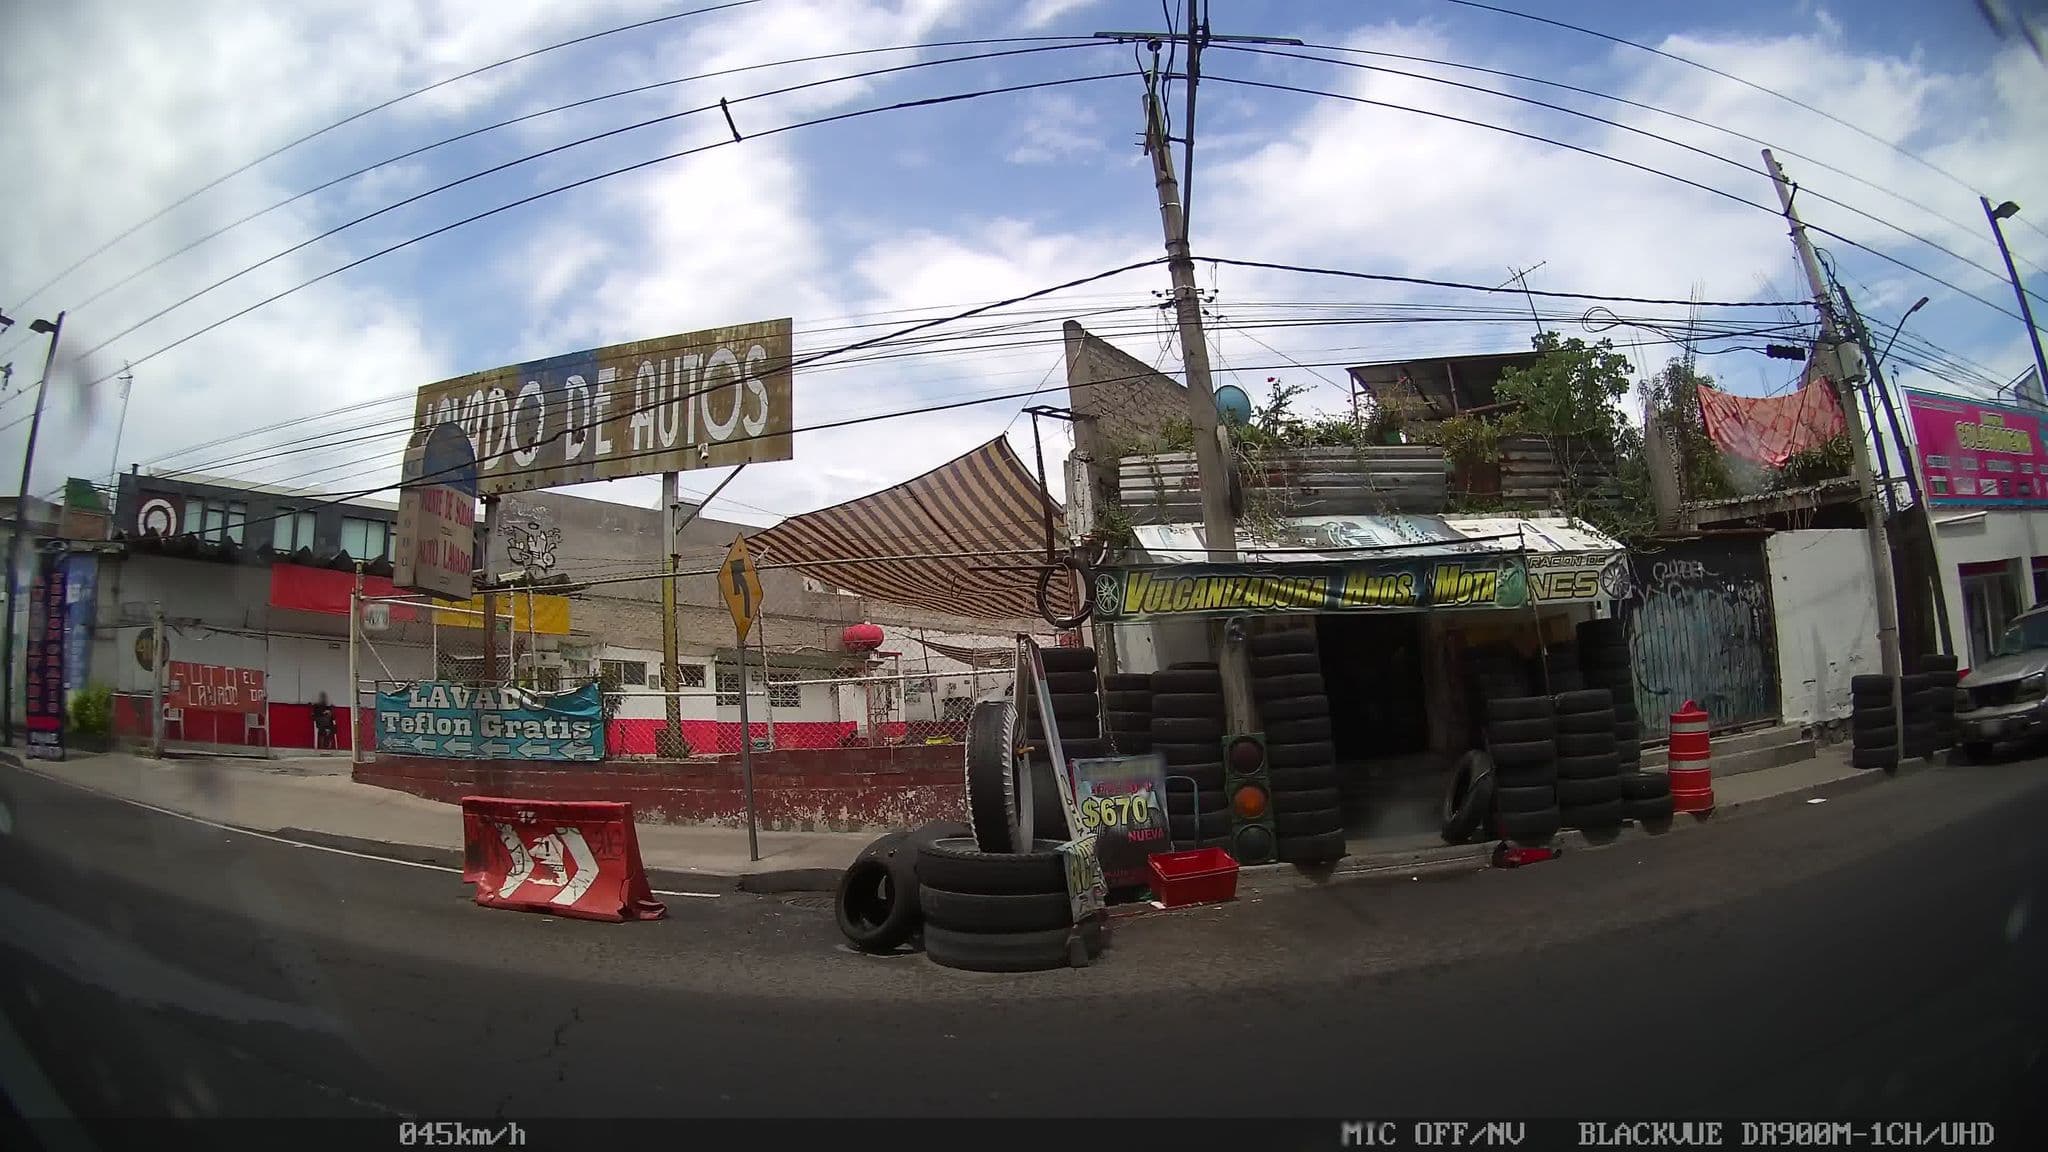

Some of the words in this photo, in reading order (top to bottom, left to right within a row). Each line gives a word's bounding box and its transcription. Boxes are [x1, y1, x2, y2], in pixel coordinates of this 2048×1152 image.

[564, 367, 616, 461] DE
[630, 344, 769, 451] AUTOS
[1123, 570, 1327, 614] VULCANIZADORA
[1433, 564, 1498, 605] MOTA
[408, 685, 545, 711] LAVAD
[381, 711, 473, 736] Teflon
[480, 714, 593, 740] Gratis
[1082, 796, 1148, 828] $670
[1128, 828, 1165, 842] NUEVA
